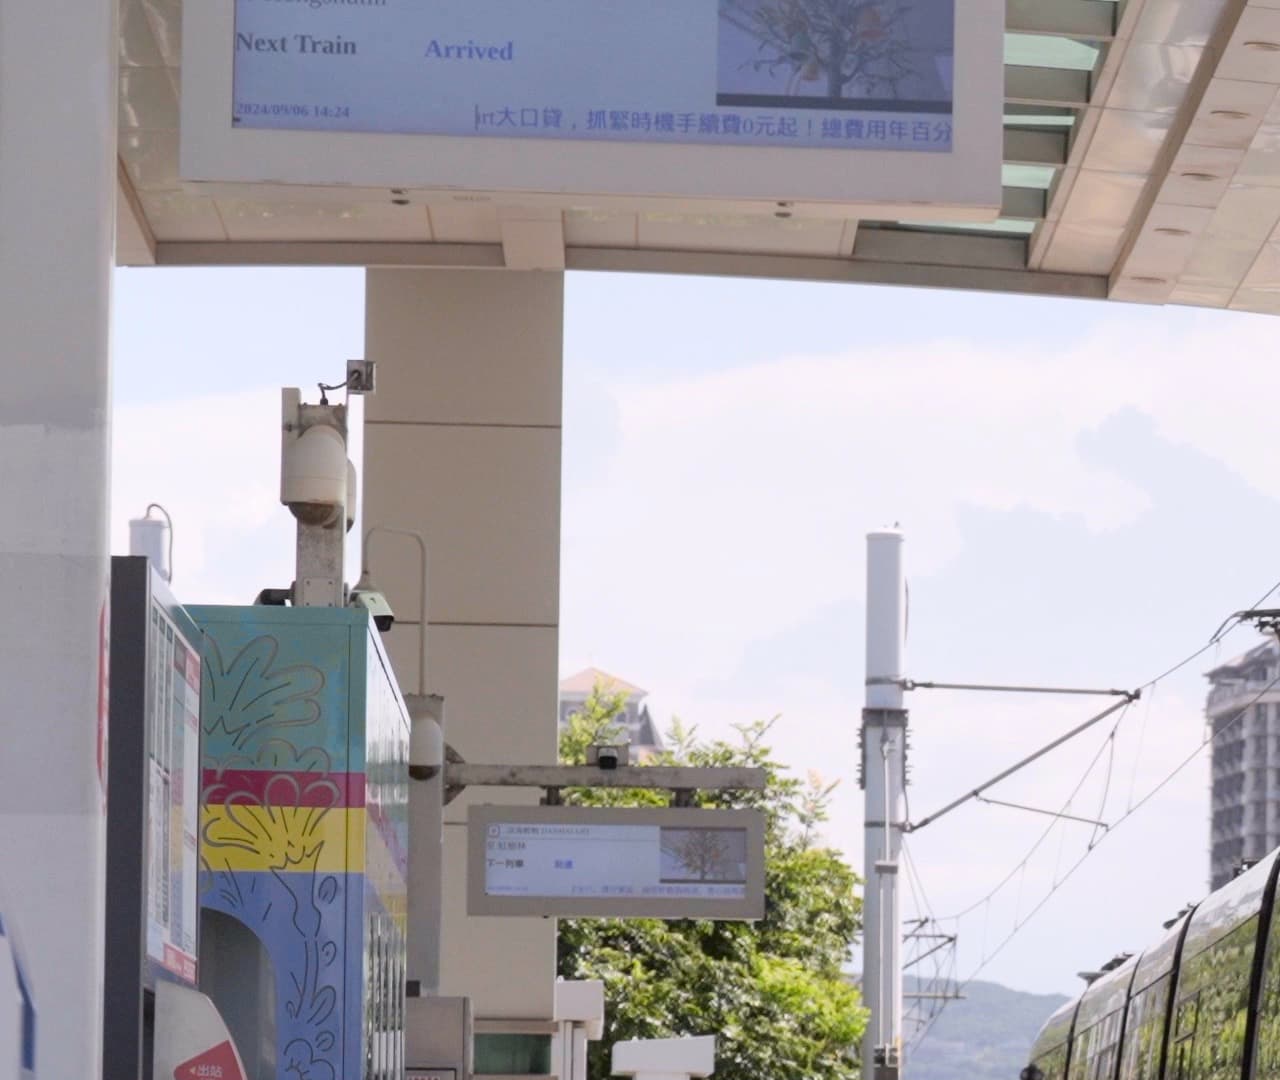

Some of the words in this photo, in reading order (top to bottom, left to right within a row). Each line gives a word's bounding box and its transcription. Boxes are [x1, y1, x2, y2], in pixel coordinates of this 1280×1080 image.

[236, 32, 288, 53] Next
[295, 34, 357, 55] Train
[425, 39, 514, 61] Arrived
[314, 105, 350, 118] 14:24
[196, 1063, 223, 1078] 出站
